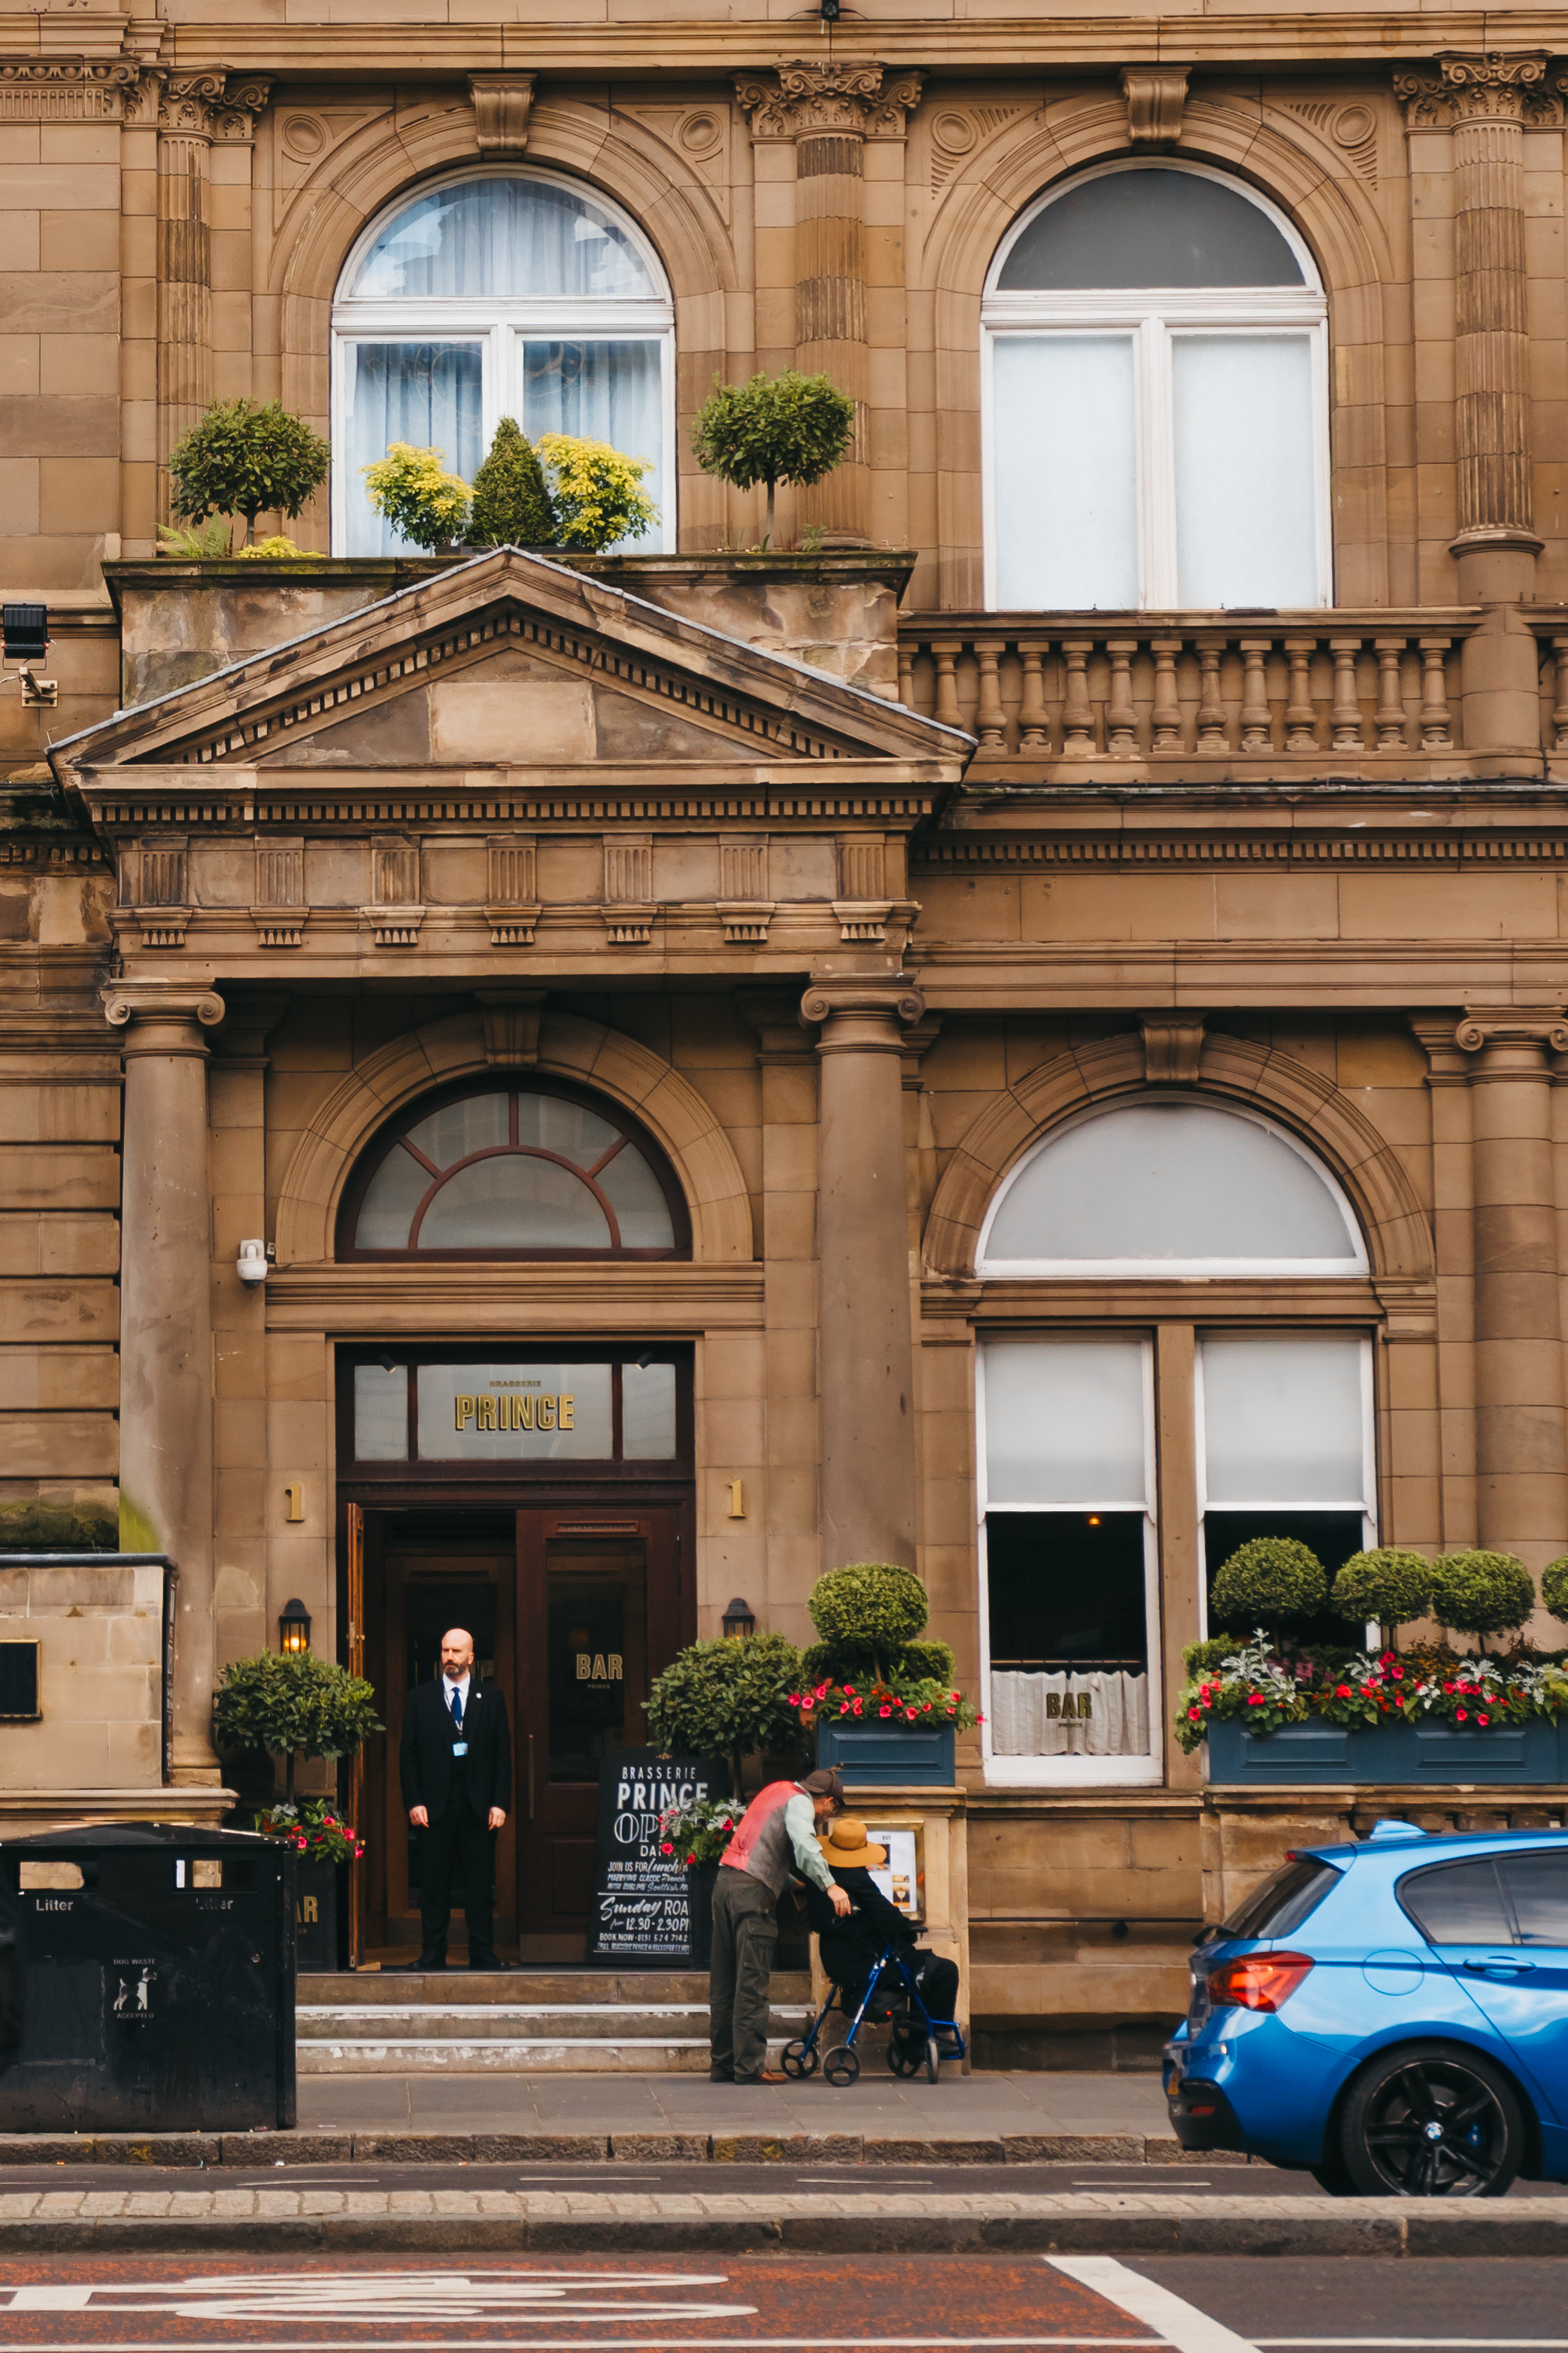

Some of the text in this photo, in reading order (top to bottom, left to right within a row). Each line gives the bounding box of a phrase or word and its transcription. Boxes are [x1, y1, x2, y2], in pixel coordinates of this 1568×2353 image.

[455, 1394, 575, 1431] PRINCE
[285, 1484, 305, 1523] 1
[726, 1479, 747, 1520] 1
[576, 1653, 623, 1680] BAR
[1046, 1692, 1093, 1720] BAR
[622, 1766, 696, 1781] BRASSERIE
[617, 1782, 708, 1810] PRINCE
[607, 1861, 623, 1872] JOIN
[625, 1861, 634, 1872] US
[635, 1861, 648, 1872] FOR
[35, 1899, 74, 1911] Litter
[600, 1896, 663, 1921] Sunday
[599, 1932, 617, 1942] BOOK
